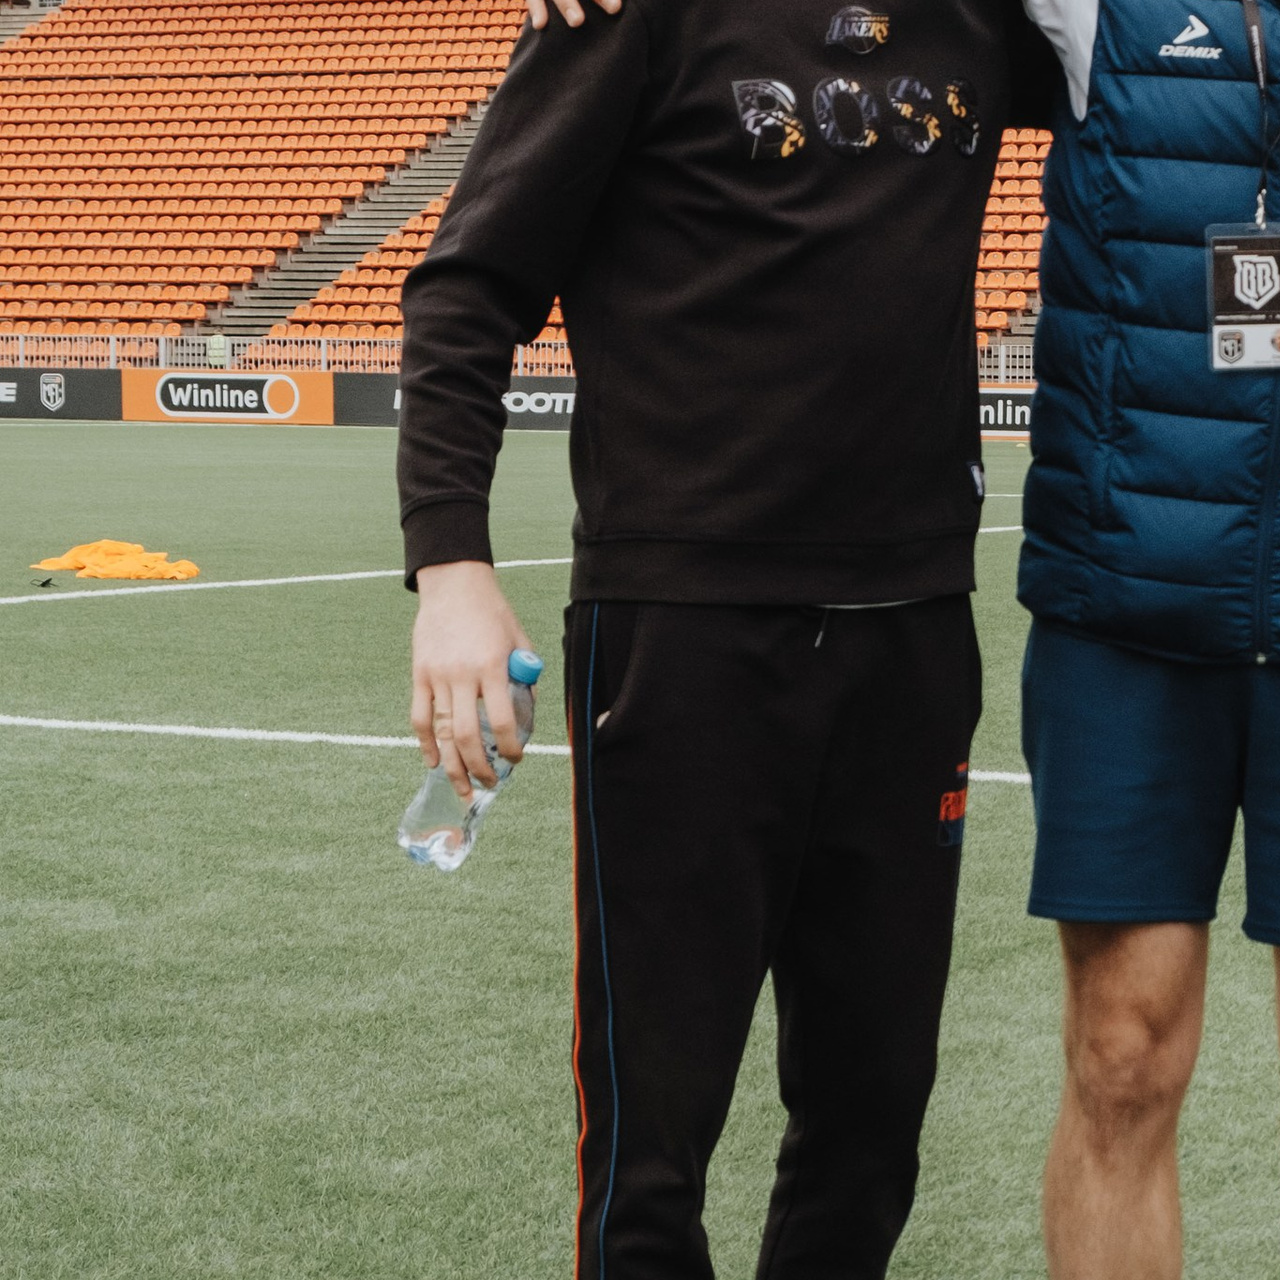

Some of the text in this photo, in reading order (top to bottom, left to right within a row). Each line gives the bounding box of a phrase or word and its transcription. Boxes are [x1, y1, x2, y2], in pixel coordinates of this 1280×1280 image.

[1158, 44, 1224, 60] DEMIX
[731, 76, 983, 160] BOSS
[168, 383, 259, 409] Winline
[501, 391, 576, 413] OOT
[979, 399, 1031, 425] nlin
